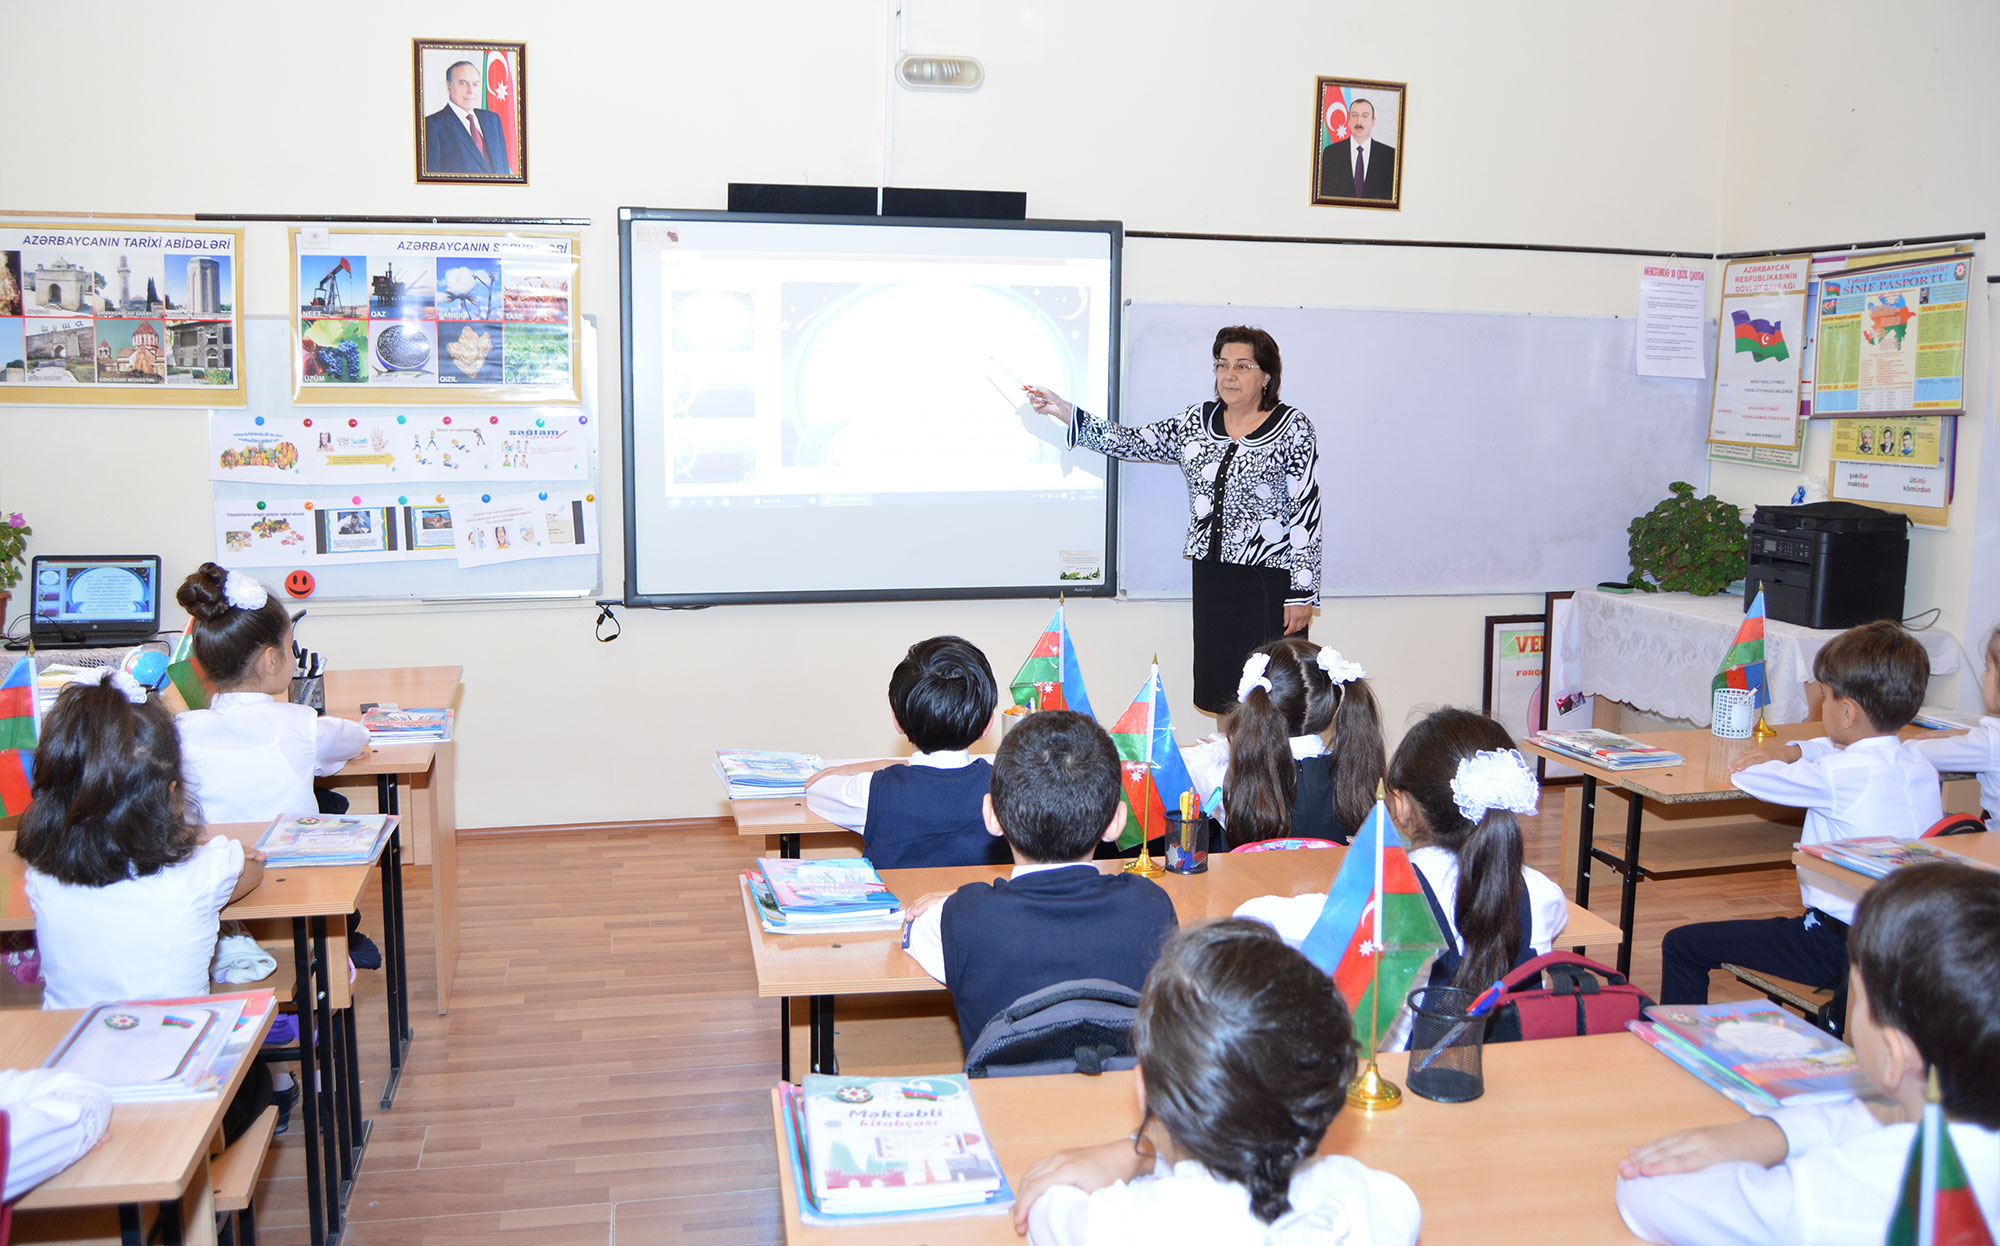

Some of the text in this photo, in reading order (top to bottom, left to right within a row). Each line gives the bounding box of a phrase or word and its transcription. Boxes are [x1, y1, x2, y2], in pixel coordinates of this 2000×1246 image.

[22, 235, 232, 250] AZƏRBAYCANIN TARİXİ ABİDƏLƏRİ
[397, 240, 491, 252] AZƏRBAYCANIN
[1743, 263, 1790, 274] AZƏRBAYCAN
[1735, 272, 1798, 283] RESPUBLİKASININ
[1843, 281, 1877, 294] SİNİF
[1879, 273, 1948, 290] PASPORTU
[371, 310, 387, 318] QAZ
[849, 1108, 943, 1118] Məktəbli
[859, 1119, 938, 1128] kitabçası
